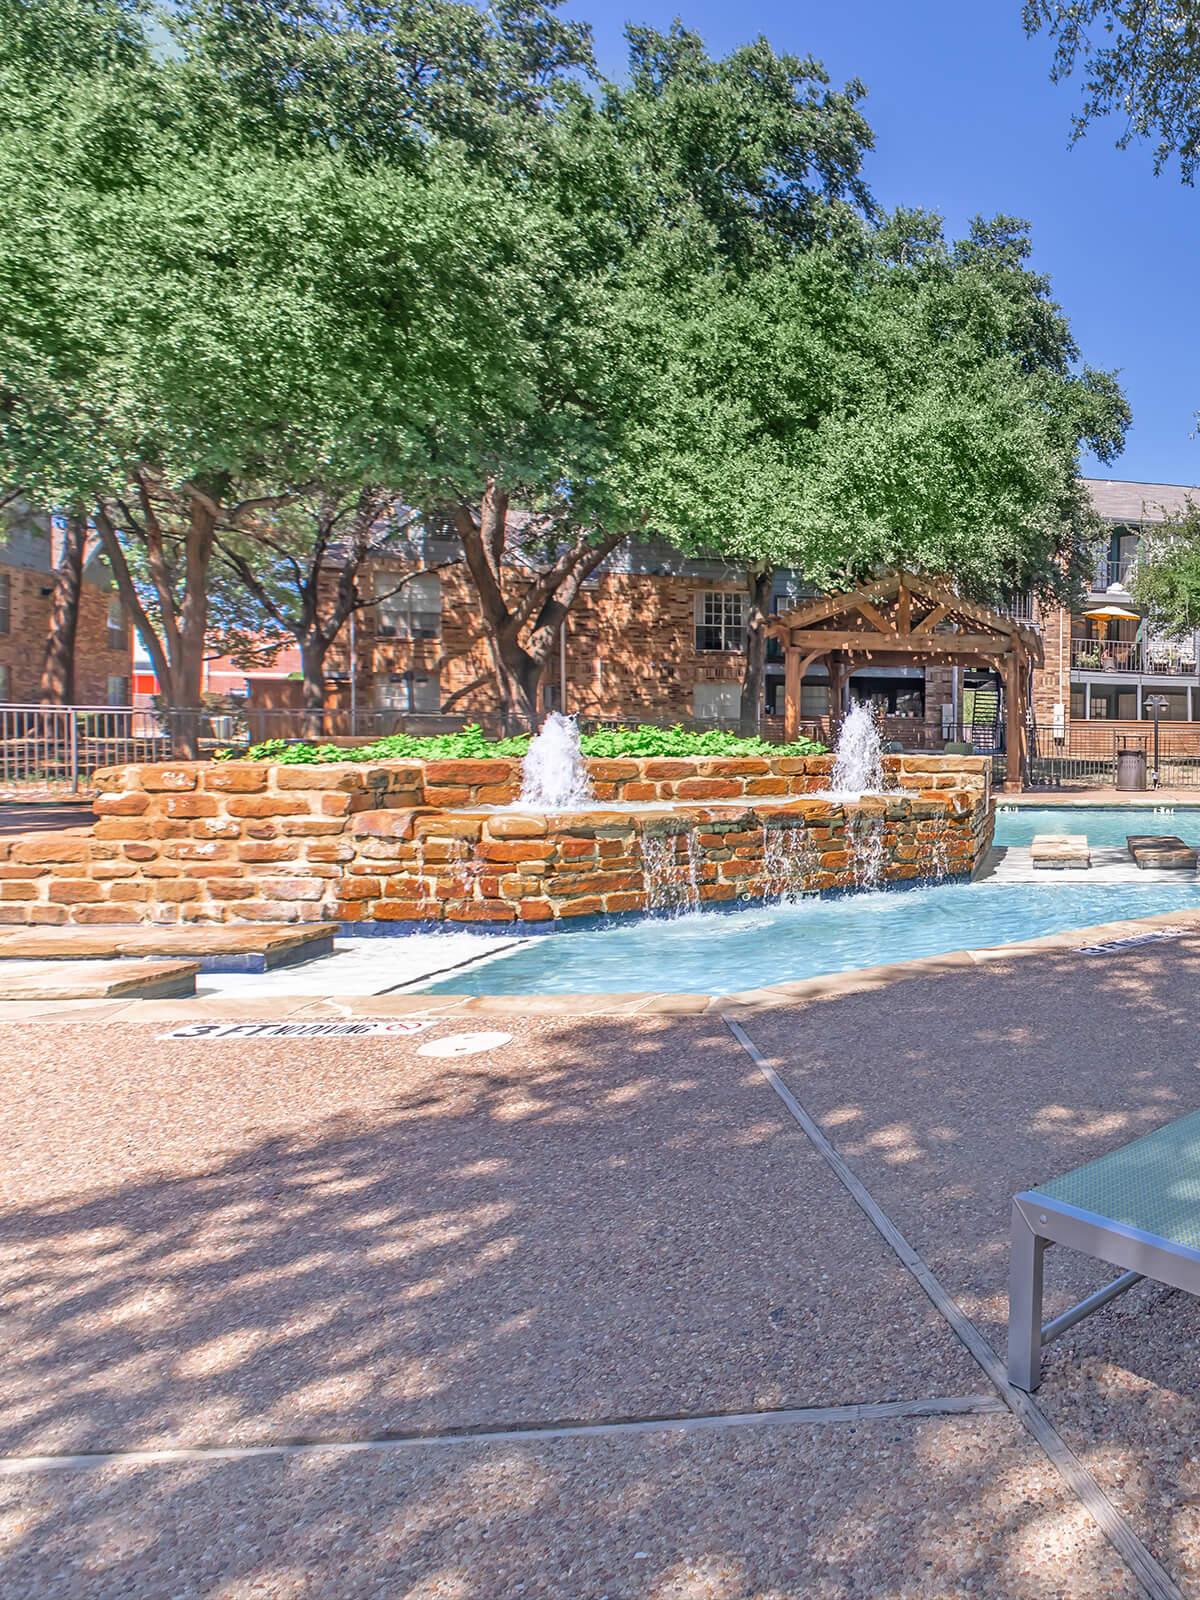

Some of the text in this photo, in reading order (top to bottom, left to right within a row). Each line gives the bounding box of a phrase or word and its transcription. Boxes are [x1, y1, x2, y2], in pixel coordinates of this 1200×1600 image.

[173, 1024, 378, 1038] 3 FT NO DIVING
